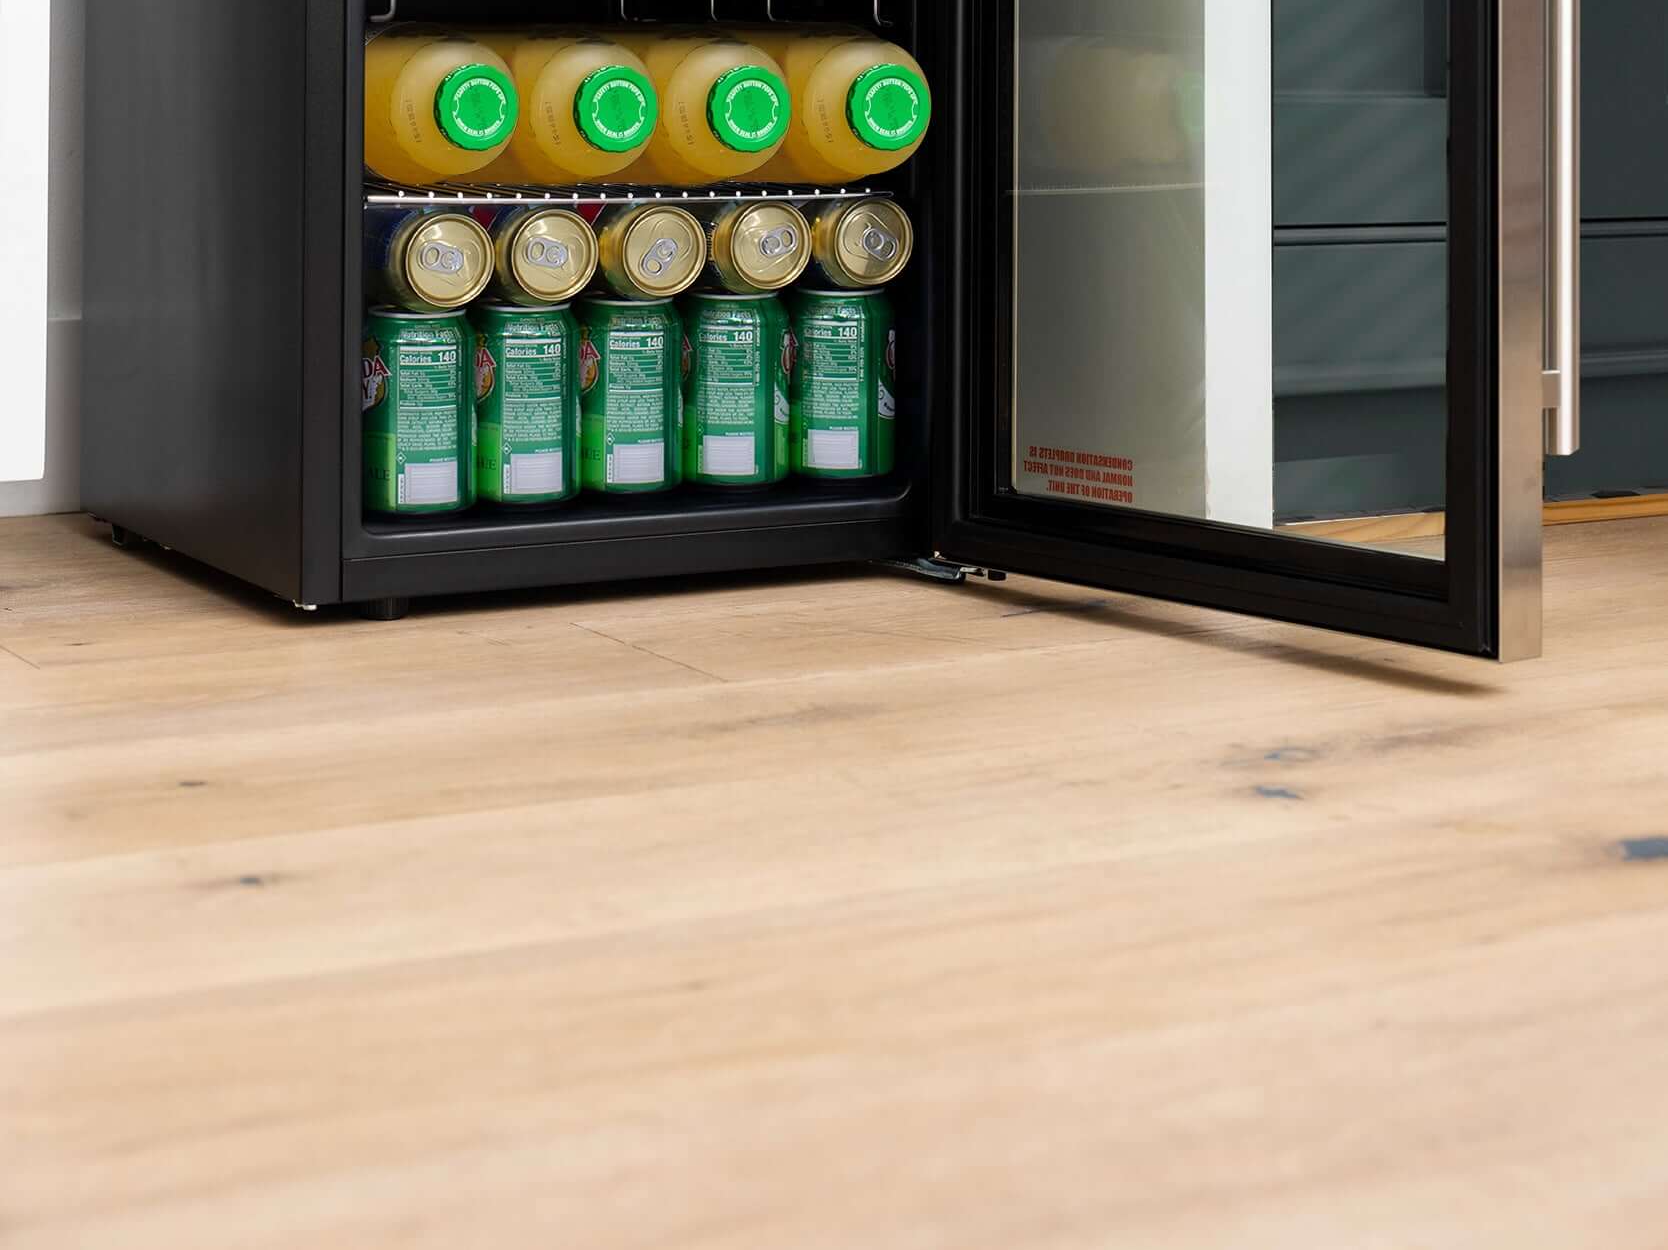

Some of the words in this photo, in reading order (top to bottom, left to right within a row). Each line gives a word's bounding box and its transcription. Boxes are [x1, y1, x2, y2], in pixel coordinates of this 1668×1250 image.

[506, 324, 539, 332] Nutrition
[805, 328, 832, 337] Calories
[838, 326, 857, 337] 140
[699, 333, 727, 341] Calories
[734, 331, 753, 341] 140
[610, 340, 640, 348] Calories
[646, 336, 664, 347] 140
[506, 347, 537, 355] Calories
[543, 343, 561, 355] 140
[400, 354, 432, 362] Calories
[438, 351, 457, 362] 140
